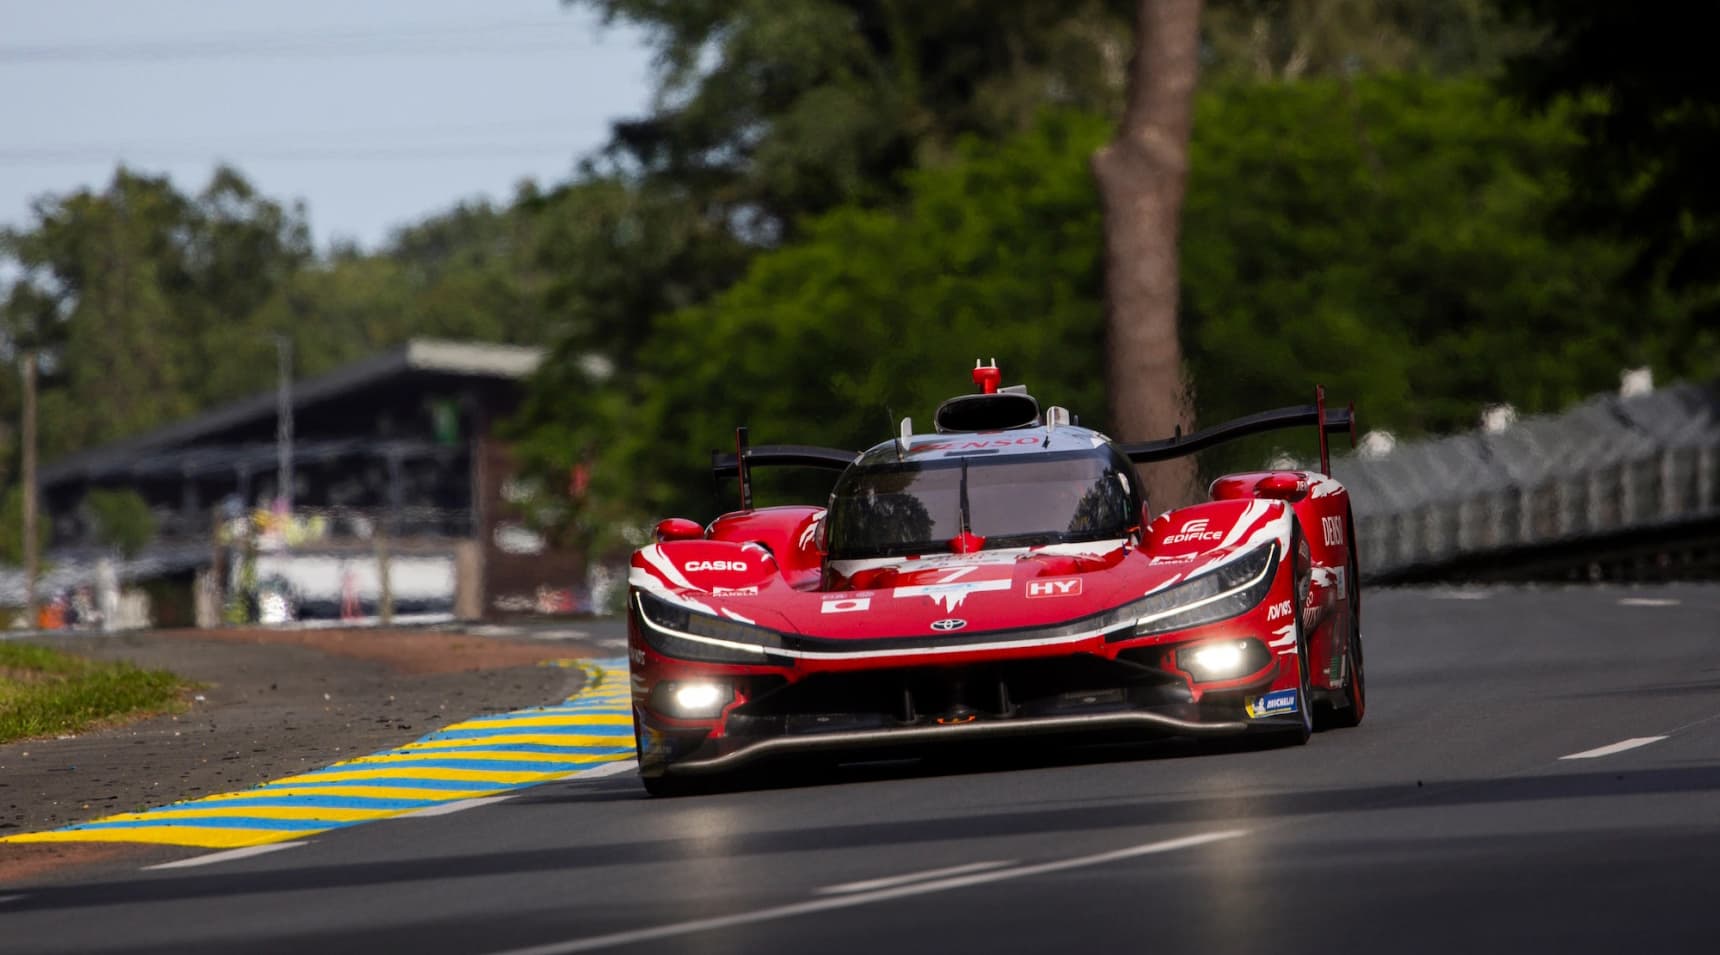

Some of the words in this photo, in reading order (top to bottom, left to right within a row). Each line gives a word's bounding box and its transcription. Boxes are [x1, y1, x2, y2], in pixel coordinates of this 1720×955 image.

[1163, 530, 1223, 545] EDIFICE
[684, 560, 748, 572] CASIO
[935, 565, 979, 584] 7
[1030, 579, 1078, 595] HY
